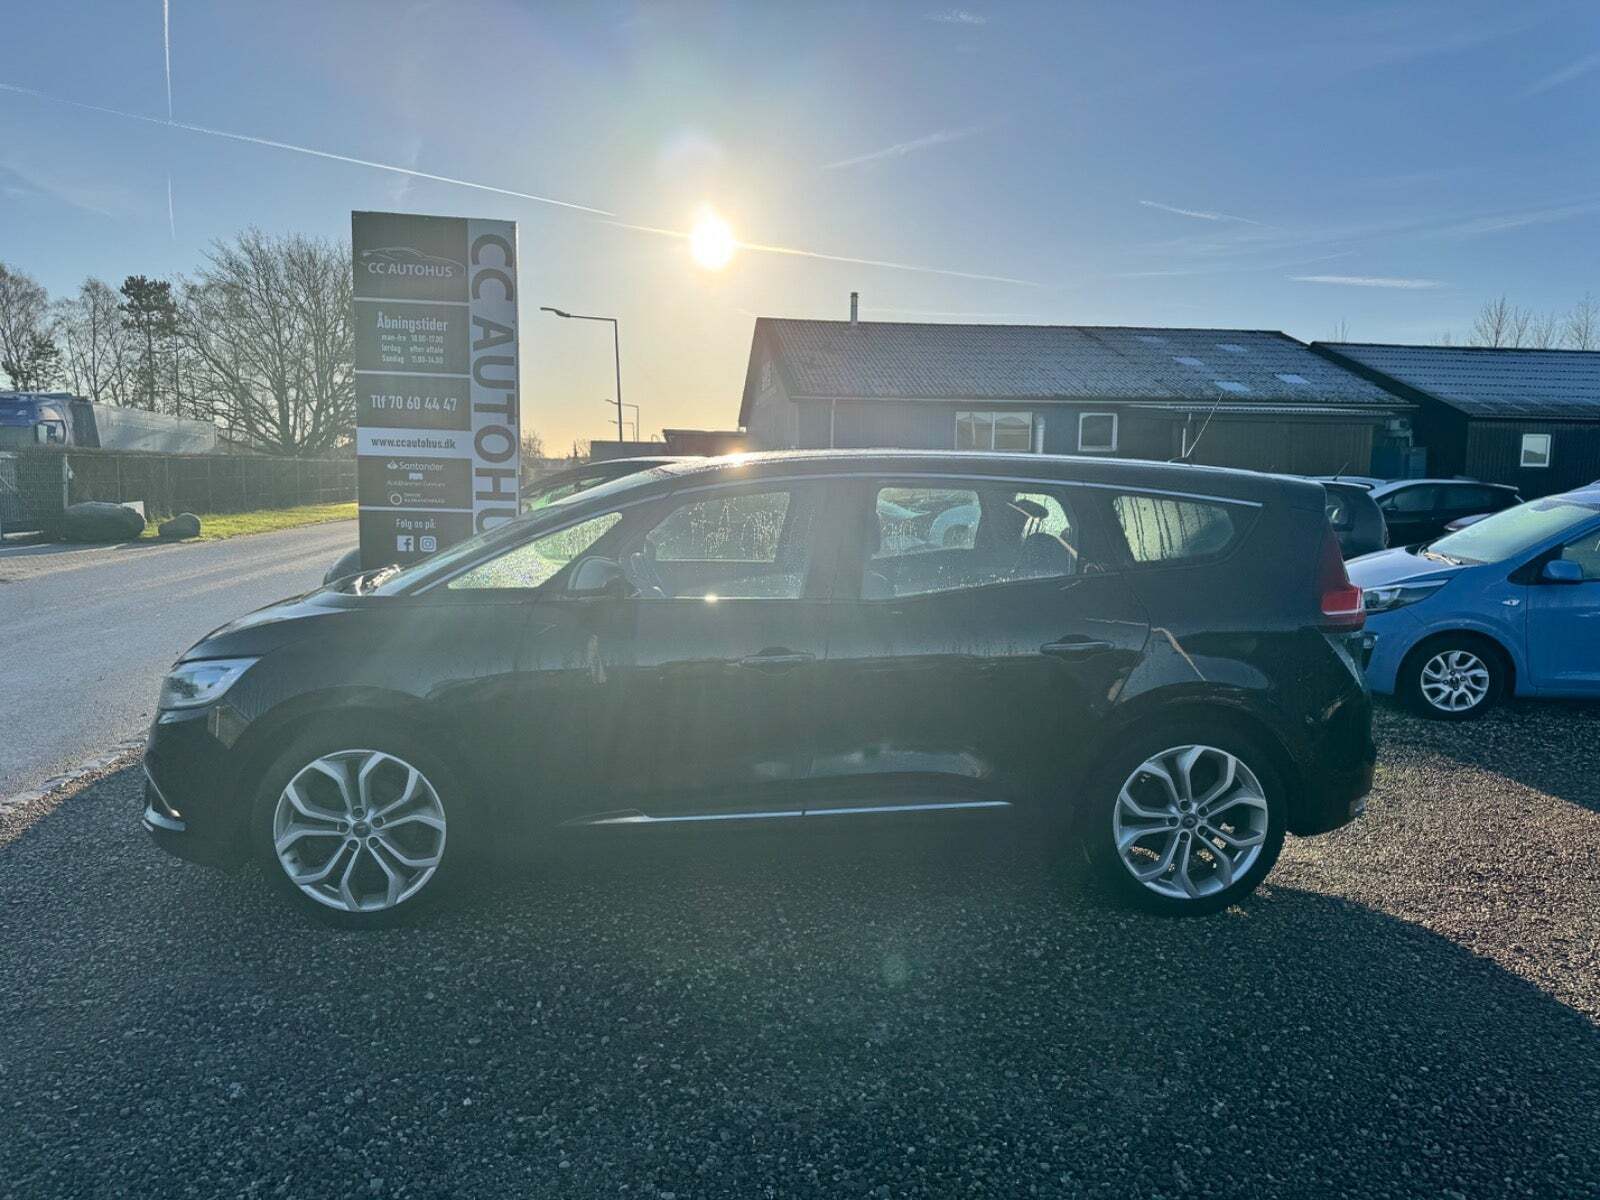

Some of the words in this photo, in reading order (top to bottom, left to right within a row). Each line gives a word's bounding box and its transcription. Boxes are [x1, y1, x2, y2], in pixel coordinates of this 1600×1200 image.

[367, 262, 385, 274] CC
[388, 263, 453, 278] AUTOHUS
[470, 233, 514, 302] CC
[377, 312, 448, 333] Åbningstider
[370, 394, 386, 409] Tlf
[389, 395, 403, 410] 70
[406, 396, 421, 410] 60
[424, 396, 440, 411] 44
[443, 397, 457, 412] 47
[472, 314, 517, 537] AUTOHU
[371, 438, 456, 450] www.ccautohus.dk
[399, 461, 444, 472] Santander
